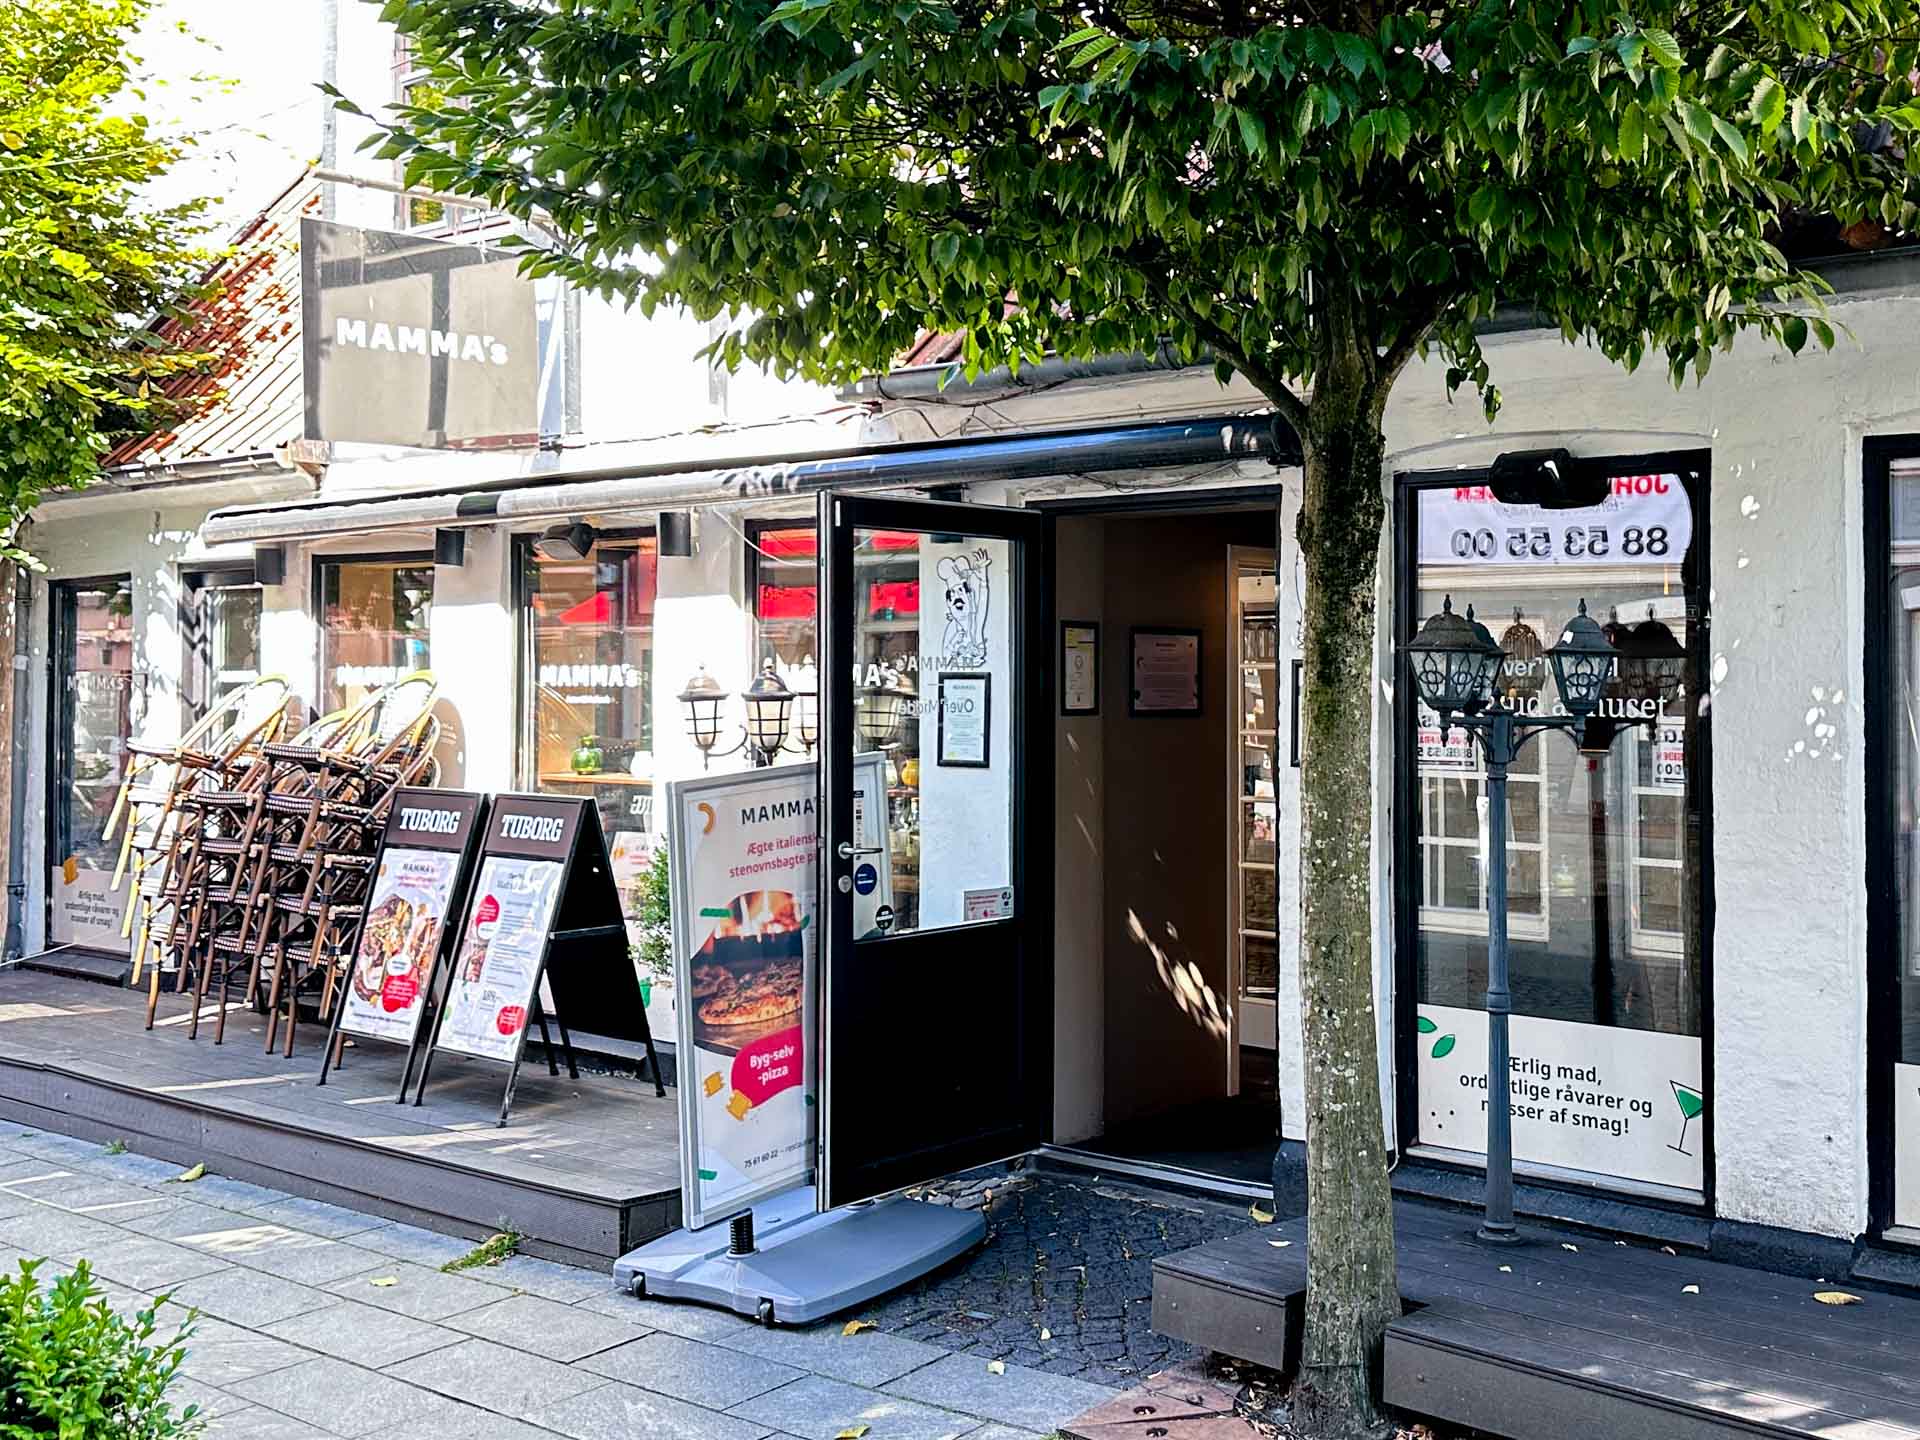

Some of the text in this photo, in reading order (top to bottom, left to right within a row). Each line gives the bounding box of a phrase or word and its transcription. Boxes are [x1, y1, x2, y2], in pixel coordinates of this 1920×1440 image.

[399, 807, 461, 834] TUBORG
[500, 814, 564, 842] TUBORG
[746, 841, 775, 857] Ægte
[729, 853, 806, 878] stenovnsbagte
[749, 1044, 795, 1069] Byg-selv
[758, 1065, 789, 1086] -pizza
[1557, 1066, 1602, 1086] mad,
[1459, 1073, 1652, 1119] ordtlige råvarer og
[1480, 1099, 1630, 1137] sser af smag!
